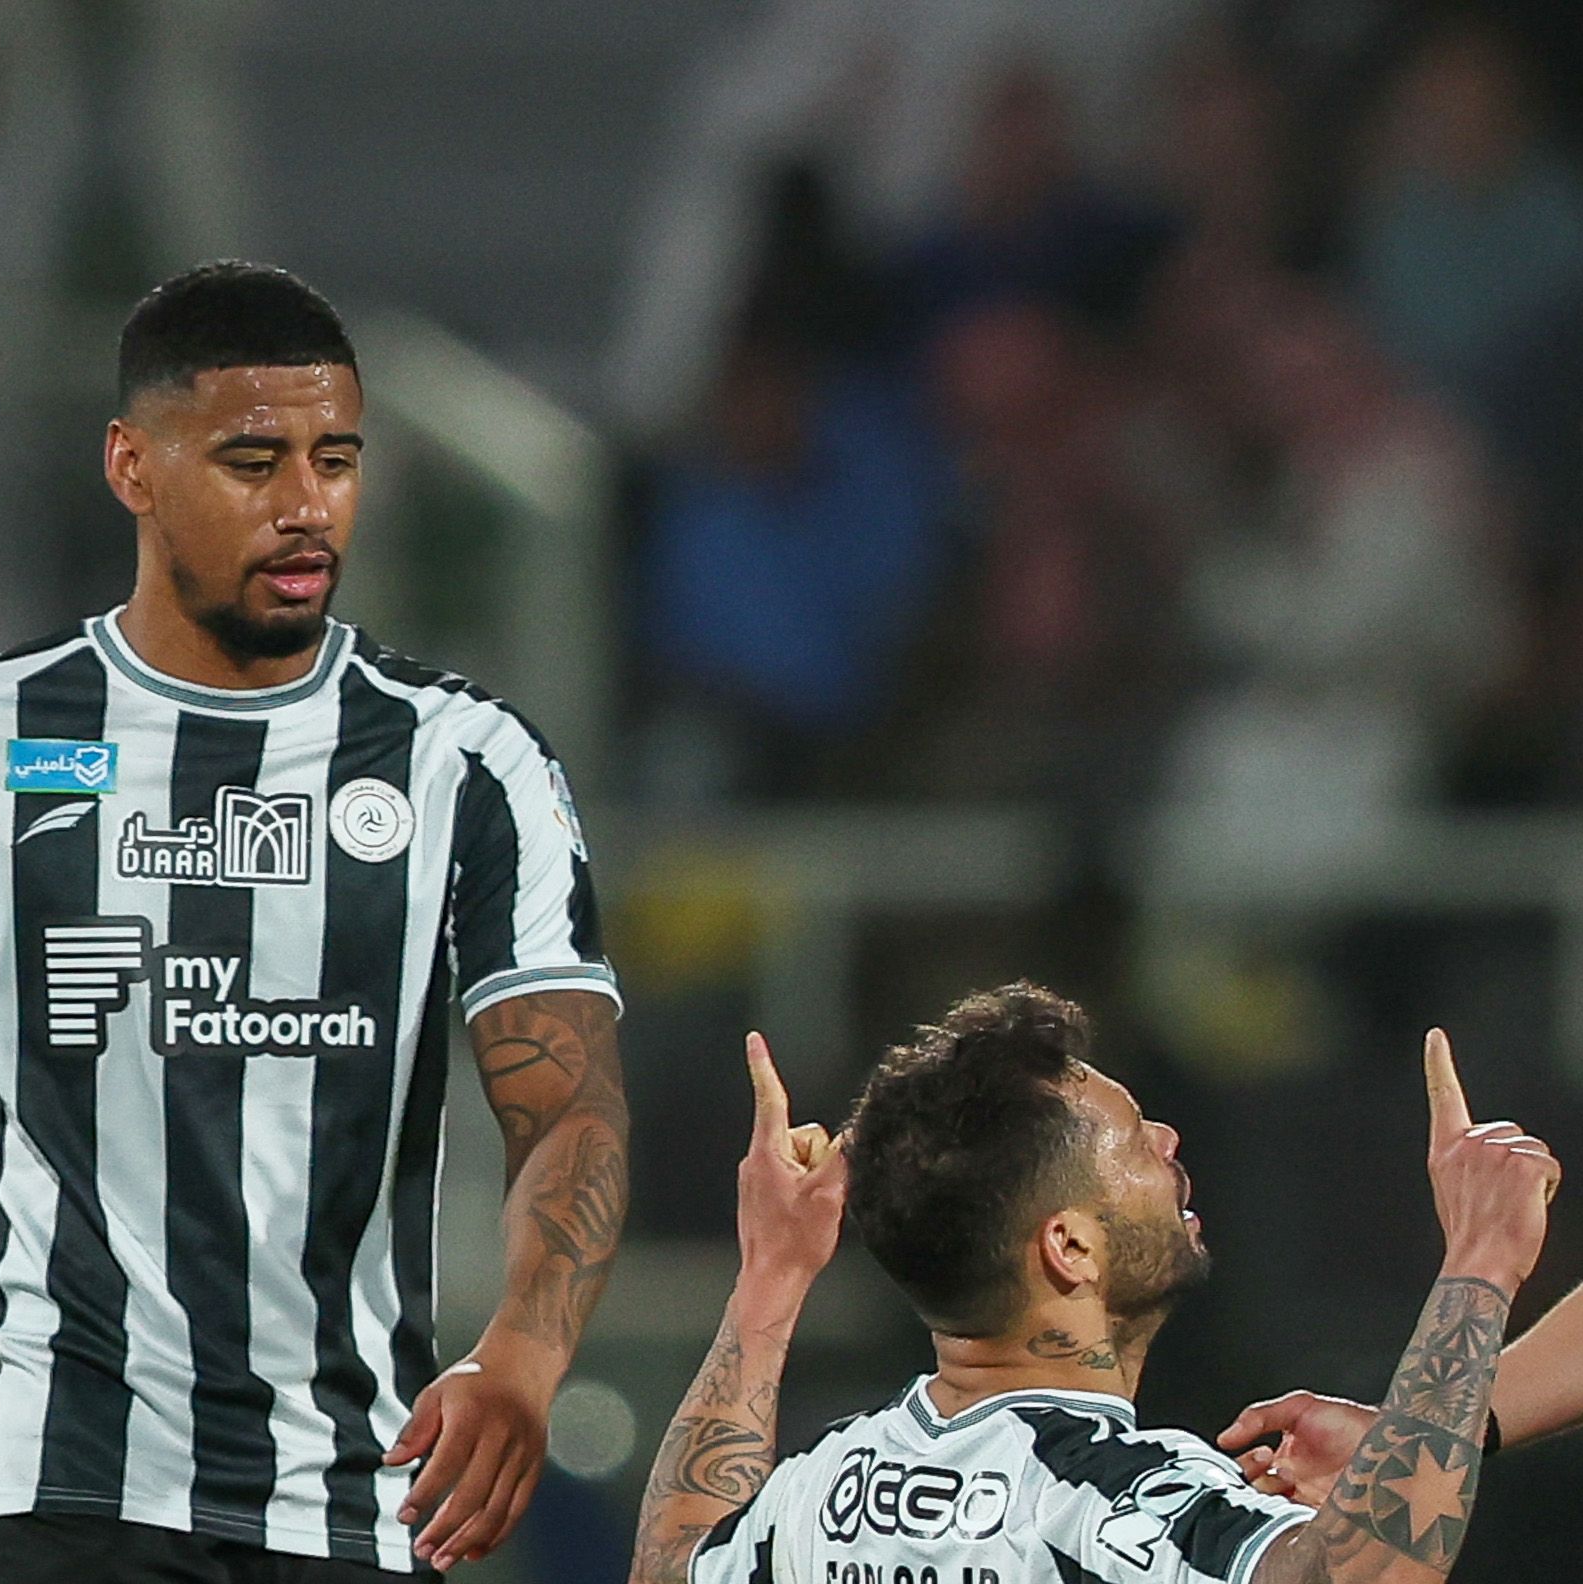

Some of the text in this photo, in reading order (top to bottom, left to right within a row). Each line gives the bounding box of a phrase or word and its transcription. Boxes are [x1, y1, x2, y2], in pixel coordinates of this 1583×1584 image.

[122, 815, 214, 849] ديار
[122, 848, 214, 876] DIAAR
[165, 957, 241, 1002] my
[166, 1000, 375, 1046] Fatoorah
